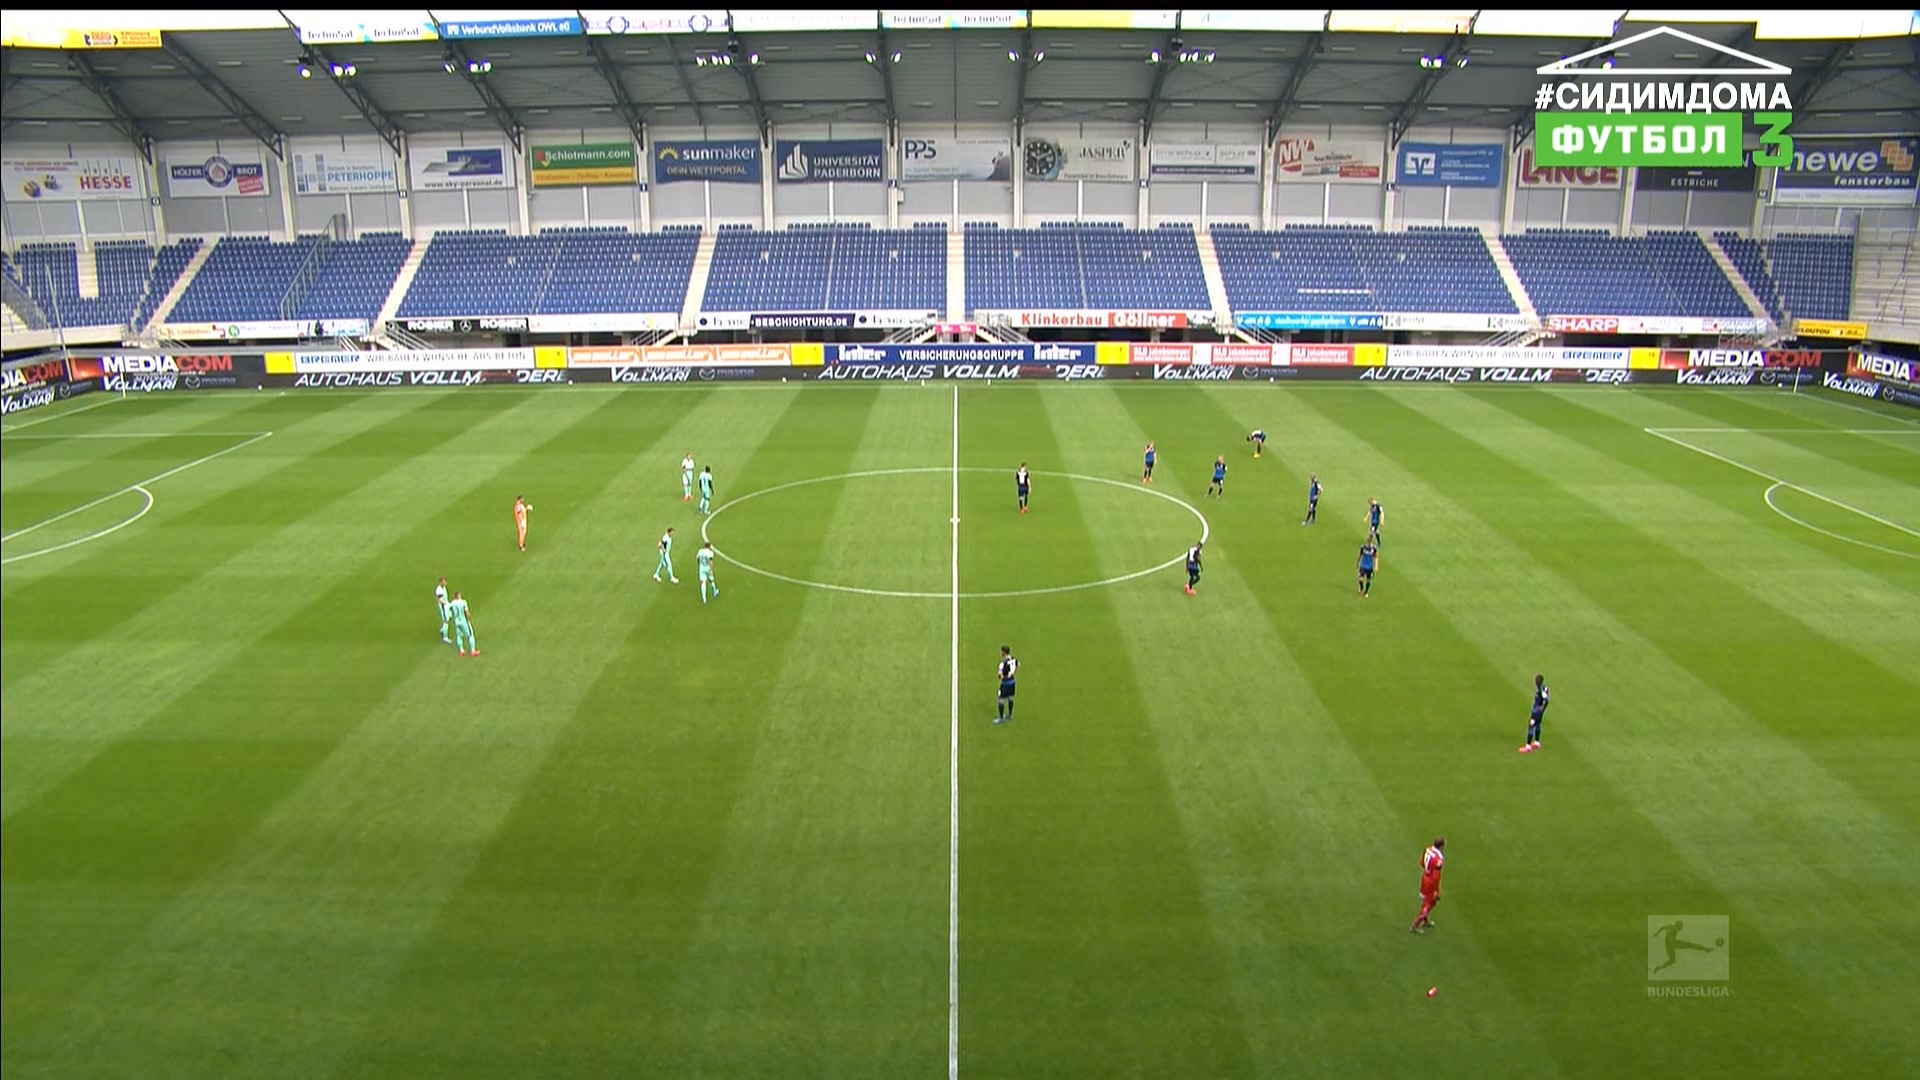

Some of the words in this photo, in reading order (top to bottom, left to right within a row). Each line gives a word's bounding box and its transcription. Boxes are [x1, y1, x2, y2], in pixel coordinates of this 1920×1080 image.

[545, 150, 630, 160] Schlotmann.com
[682, 145, 756, 160] sunmaker
[905, 140, 936, 159] PPS
[1079, 147, 1125, 158] JASPER
[814, 155, 880, 166] UNIVERSITÄT
[173, 167, 201, 177] HÖLTER
[327, 171, 393, 182] PETERHOPPE
[667, 166, 687, 176] DEIN
[690, 166, 747, 175] WETTPORTAL
[814, 167, 880, 178] PADERBORN
[80, 176, 132, 190] HESSE
[1670, 178, 1719, 188] ESTRICHE
[1834, 176, 1910, 186] fensterbau
[1021, 312, 1102, 325] Klinkerbau
[1113, 312, 1176, 326] Göllner
[1548, 318, 1618, 330] SHARP
[899, 350, 1024, 360] VERSICHERUNGSGRUPPE
[1688, 350, 1822, 366] MEDIACOM
[103, 354, 233, 372] MEDIACOM
[1, 361, 64, 389] DIACOM
[818, 366, 936, 379] AUTOHAUS
[1359, 368, 1471, 382] AUTOHAUS
[295, 372, 403, 386] AUTOHAUS
